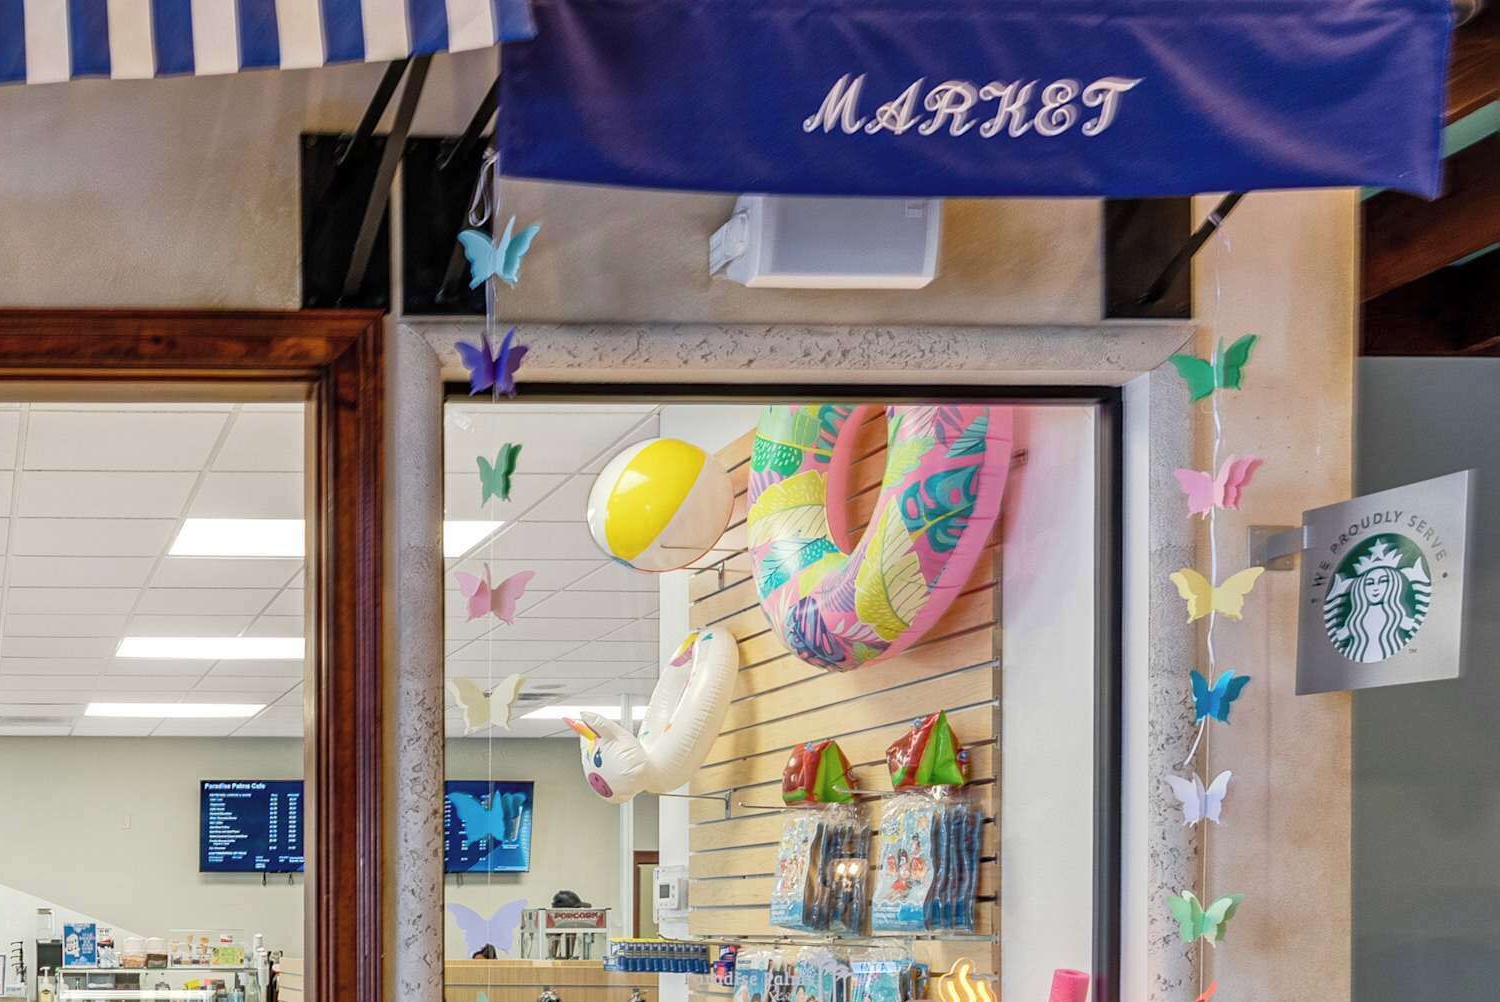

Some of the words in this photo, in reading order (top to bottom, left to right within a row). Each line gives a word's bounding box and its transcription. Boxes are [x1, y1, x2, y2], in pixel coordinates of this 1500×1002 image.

[802, 72, 1146, 138] MARKET
[1311, 559, 1331, 588] WE
[1330, 510, 1404, 554] PROUDLY
[1407, 514, 1448, 562] SERVE
[554, 911, 598, 919] POPCORN
